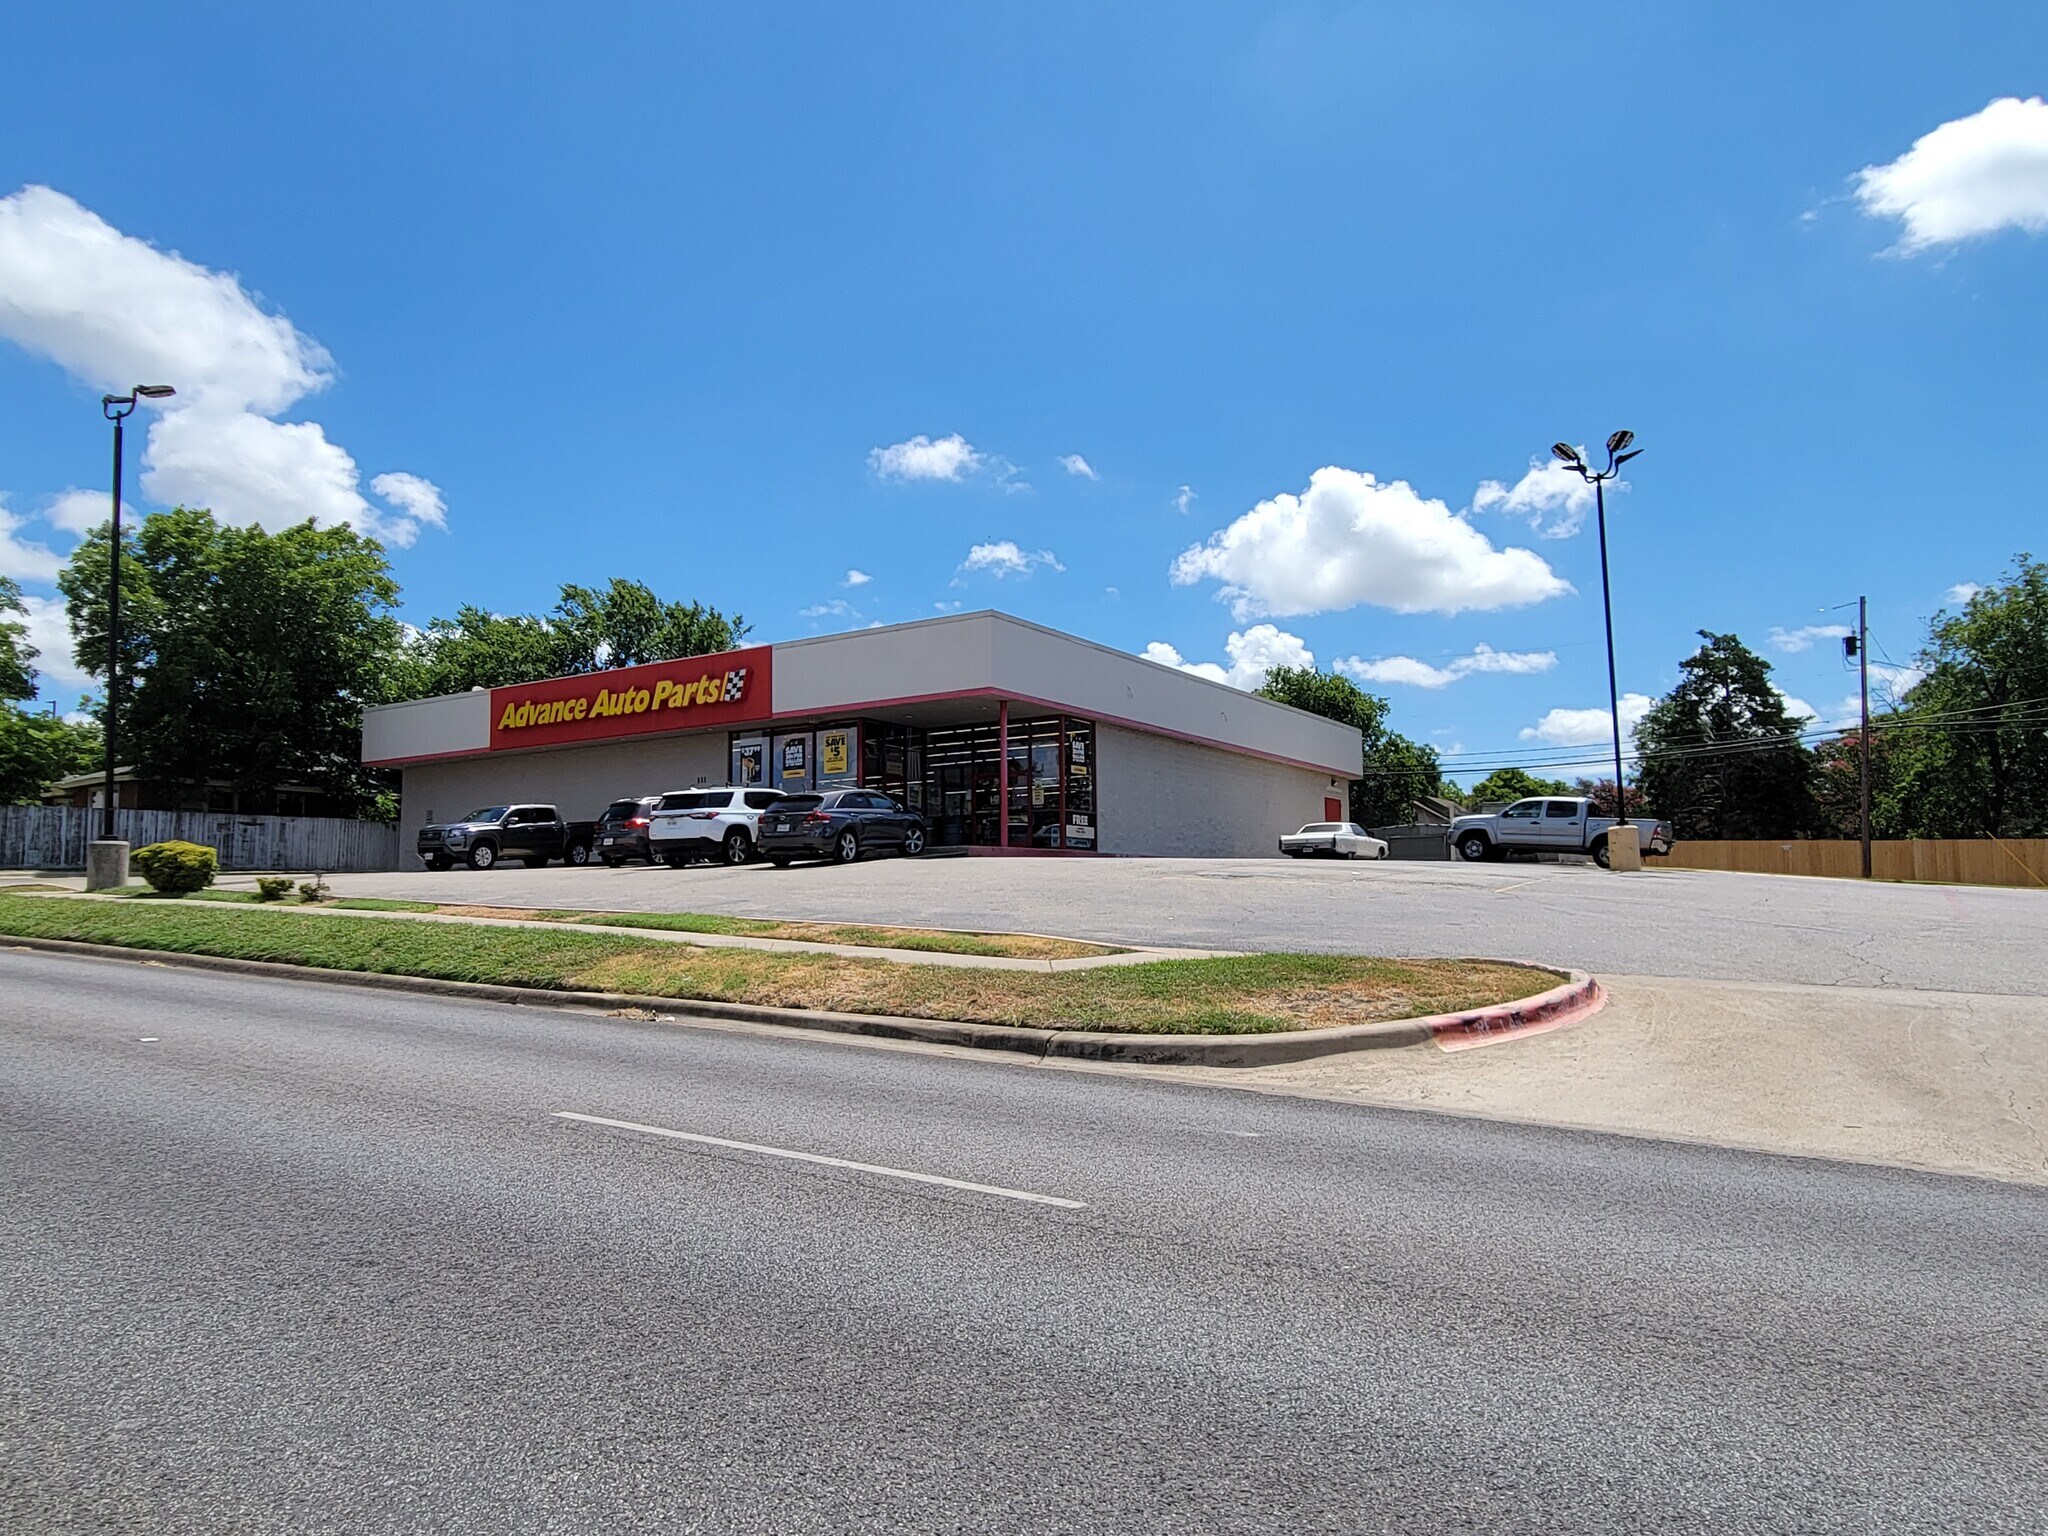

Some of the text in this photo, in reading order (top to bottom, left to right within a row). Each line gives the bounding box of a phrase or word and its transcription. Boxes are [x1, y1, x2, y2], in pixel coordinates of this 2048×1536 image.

[497, 674, 720, 730] Advance Auto Parts
[825, 738, 845, 747] SAVE
[1072, 814, 1088, 825] FREE
